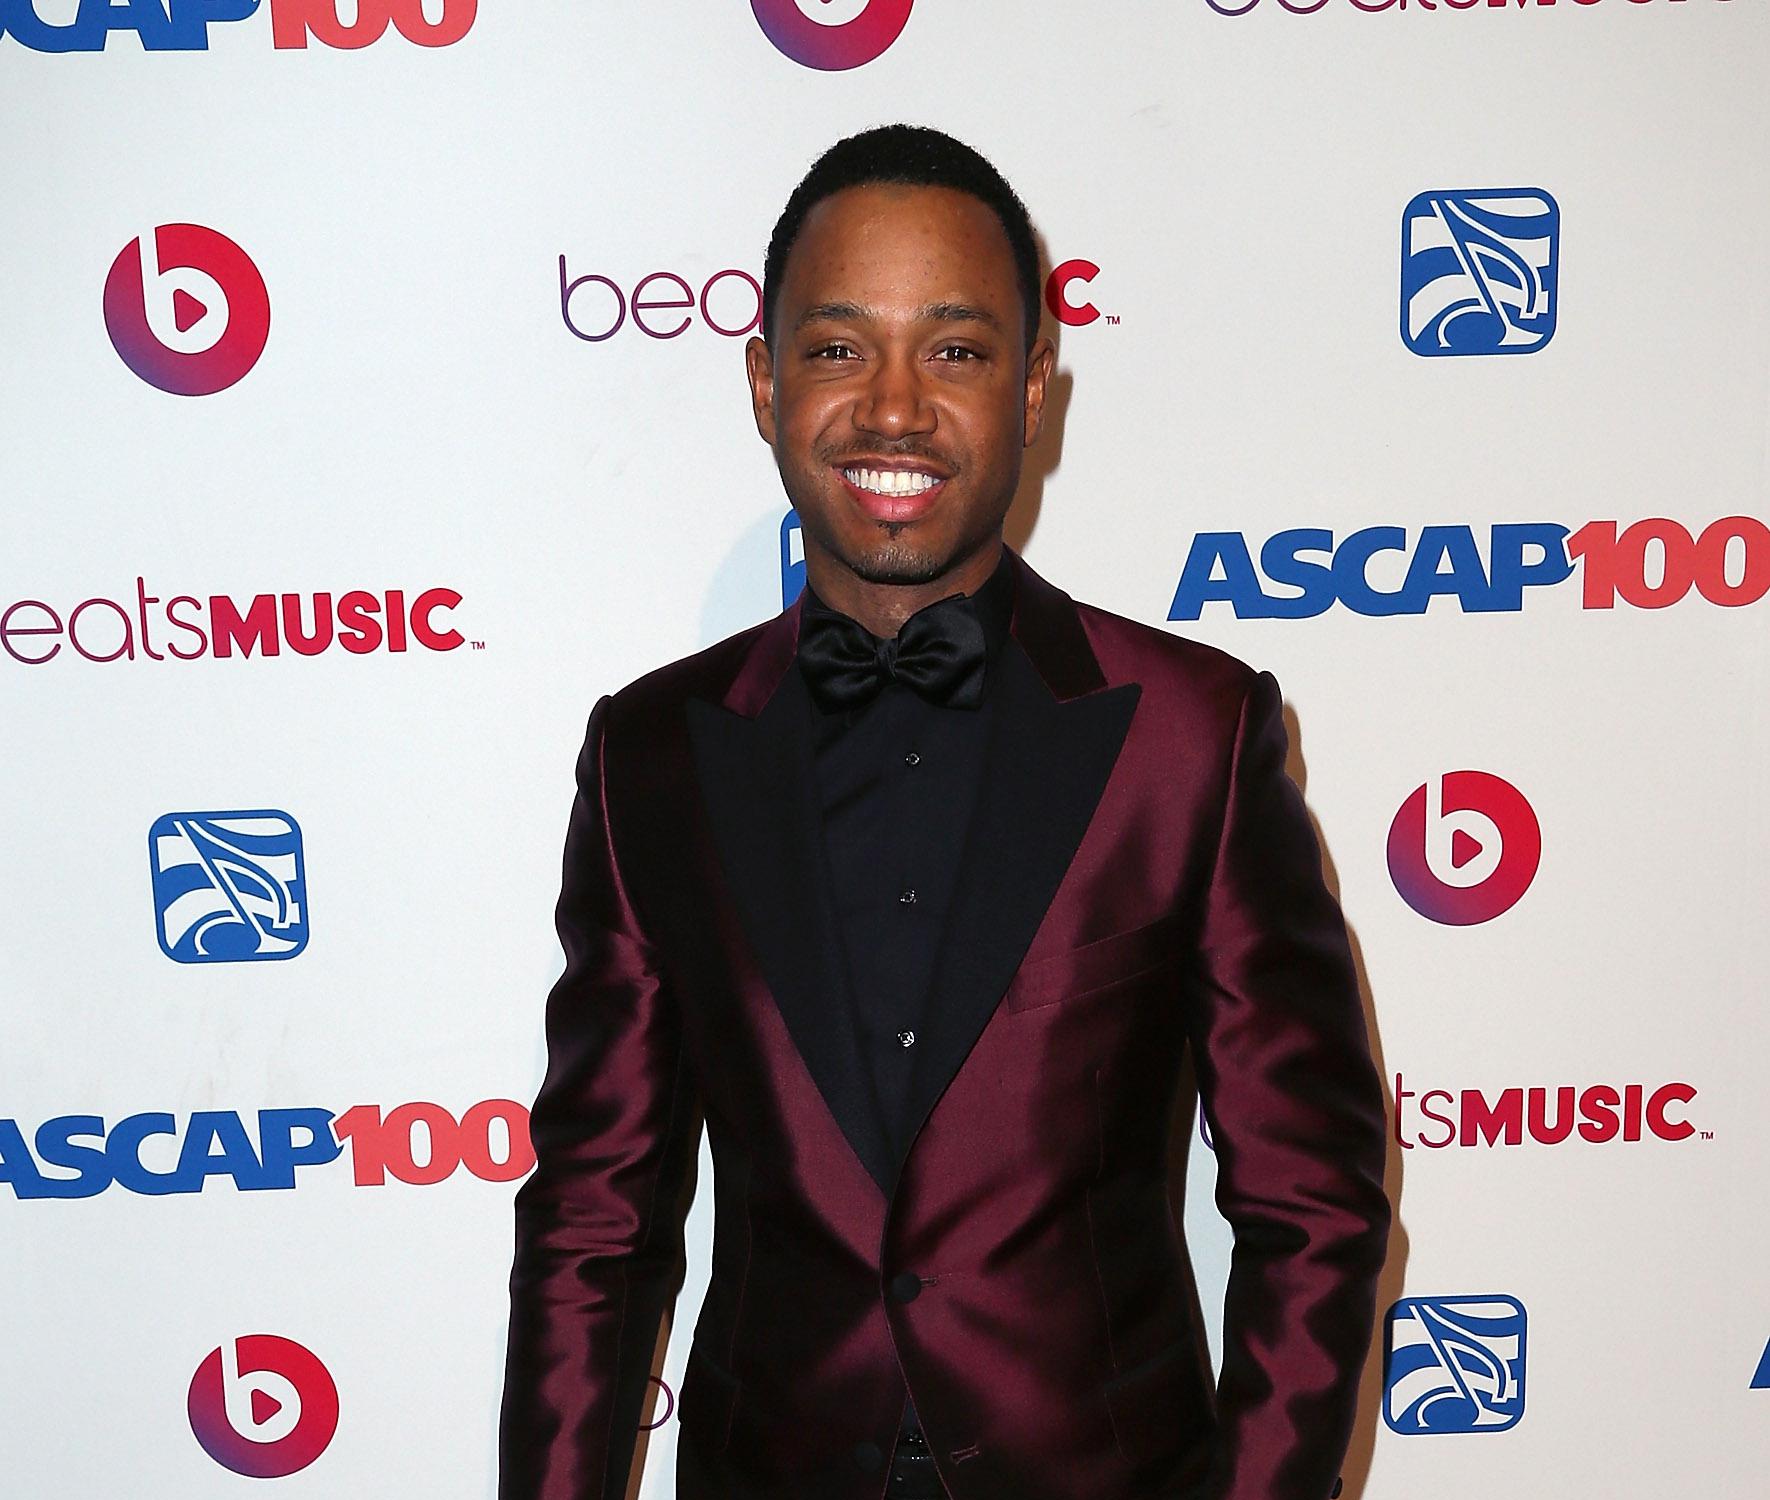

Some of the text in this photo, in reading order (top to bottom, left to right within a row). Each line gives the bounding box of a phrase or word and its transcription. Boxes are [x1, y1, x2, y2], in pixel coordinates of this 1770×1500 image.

[1167, 516, 1770, 622] ASCAP100
[0, 576, 466, 665] eatsMUSIC
[1394, 1073, 1698, 1149] tsMUSIC
